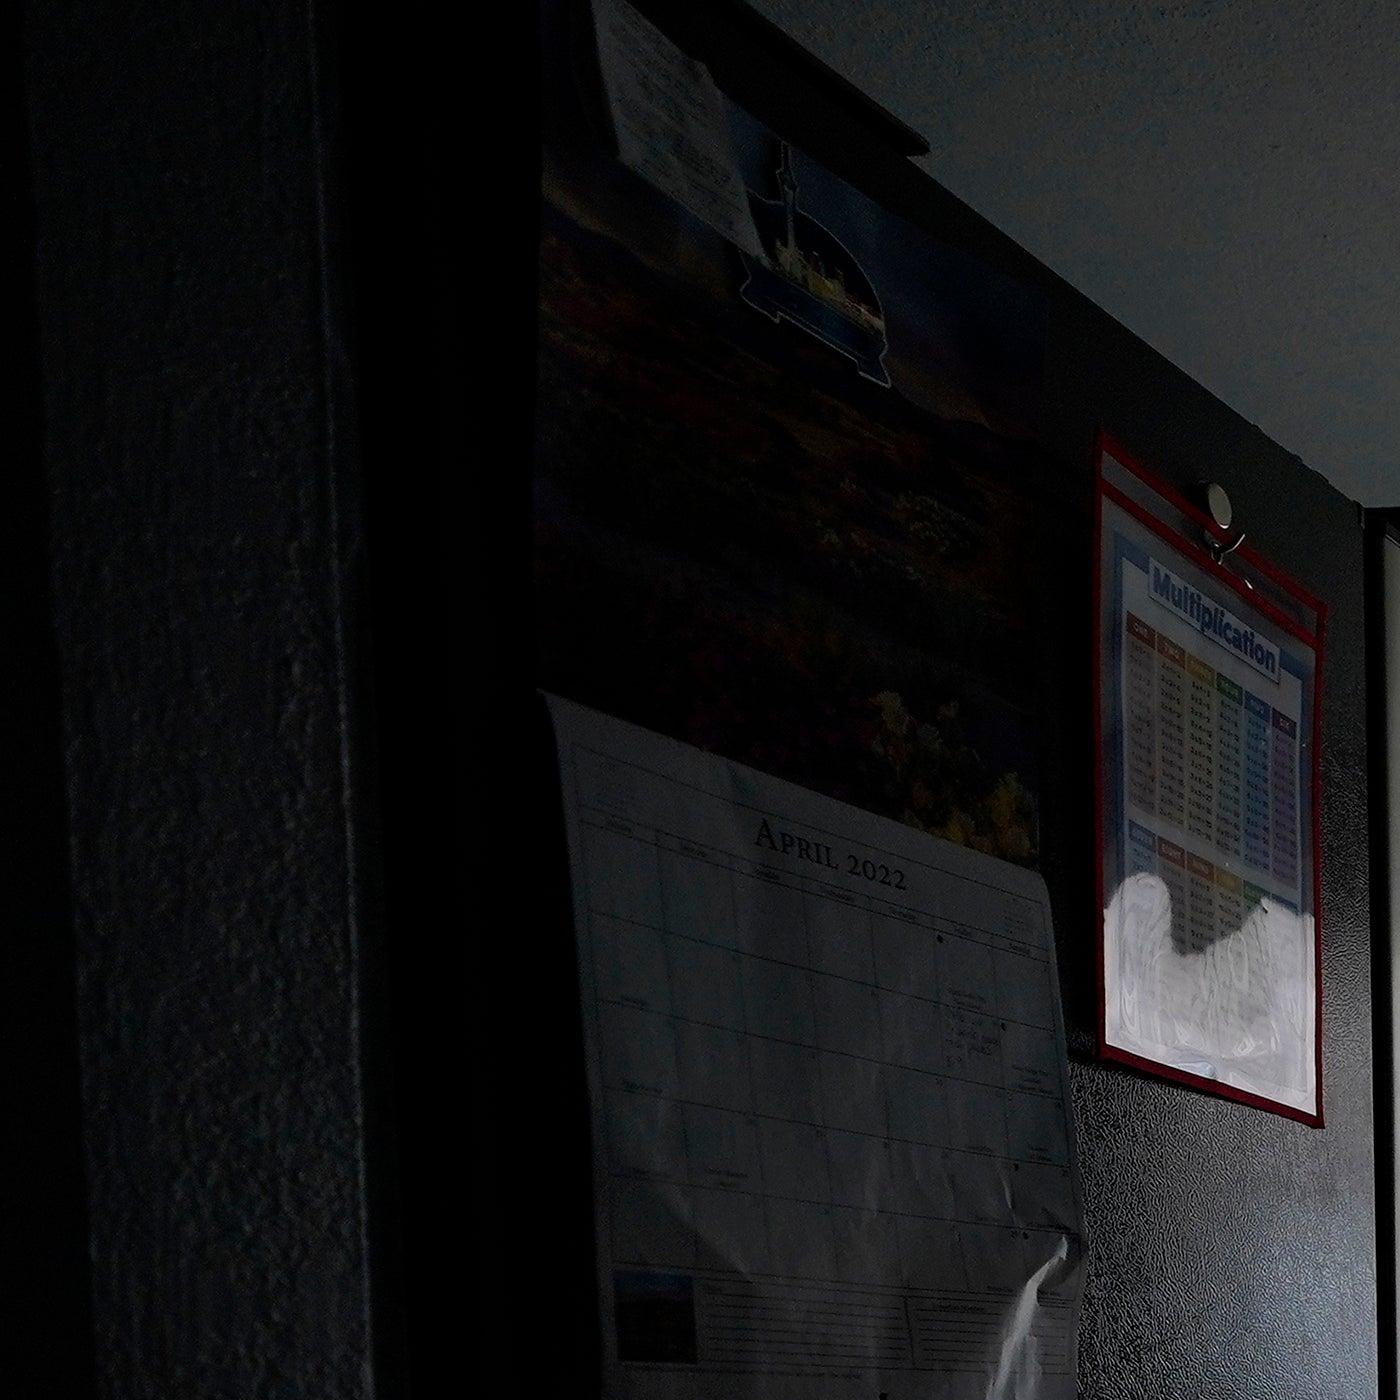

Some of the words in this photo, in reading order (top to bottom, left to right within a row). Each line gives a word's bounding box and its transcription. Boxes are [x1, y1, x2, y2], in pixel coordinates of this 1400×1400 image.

[1153, 566, 1275, 674] Multiplication
[755, 818, 839, 869] APRIL
[847, 854, 908, 890] 2022
